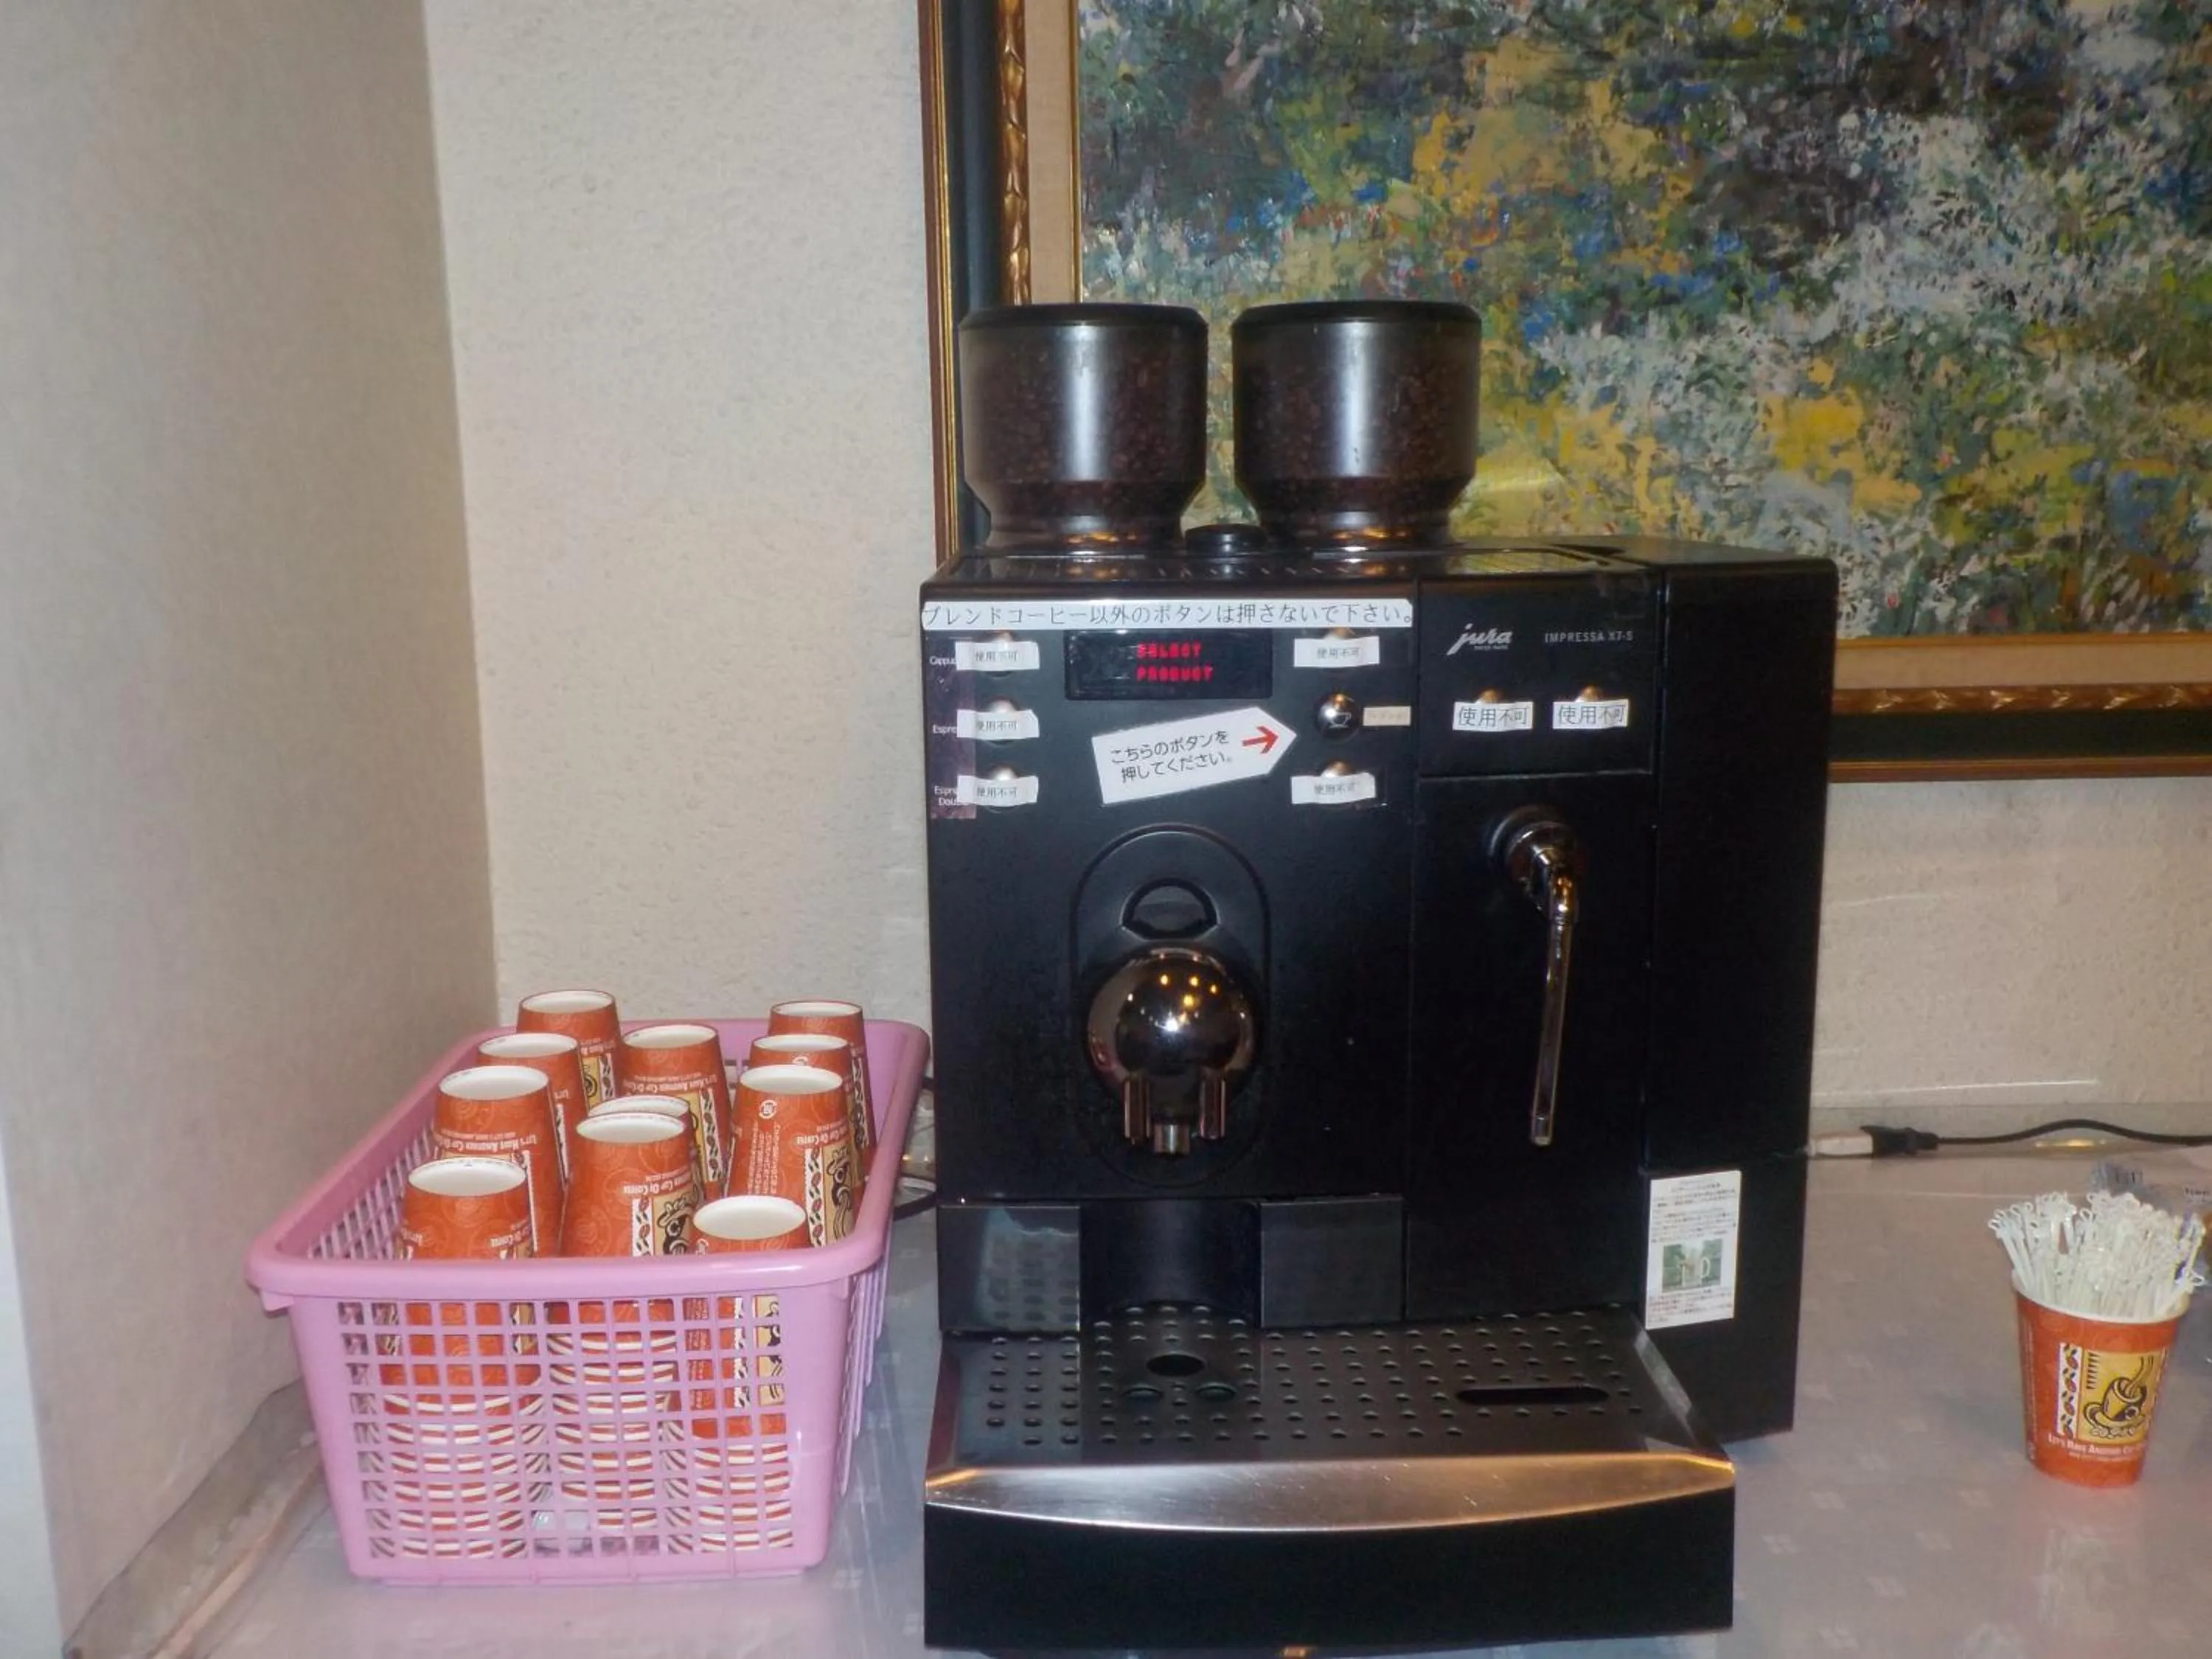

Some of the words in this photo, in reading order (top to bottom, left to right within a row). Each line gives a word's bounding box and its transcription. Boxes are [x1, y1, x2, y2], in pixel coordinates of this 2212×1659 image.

[922, 604, 1412, 625] ブレンドコーヒー以外のボタンは押さないで下さい。
[1446, 623, 1512, 655] jura
[1545, 631, 1605, 643] IMPRESSA
[1137, 642, 1201, 658] SELECT
[930, 655, 956, 667] Cappuc
[1137, 665, 1212, 682] PRODUCT
[1458, 706, 1528, 727] 使用不可
[932, 724, 956, 736] Espre
[1110, 731, 1229, 764] こちらのボタンを
[1121, 751, 1232, 783] 押してください。
